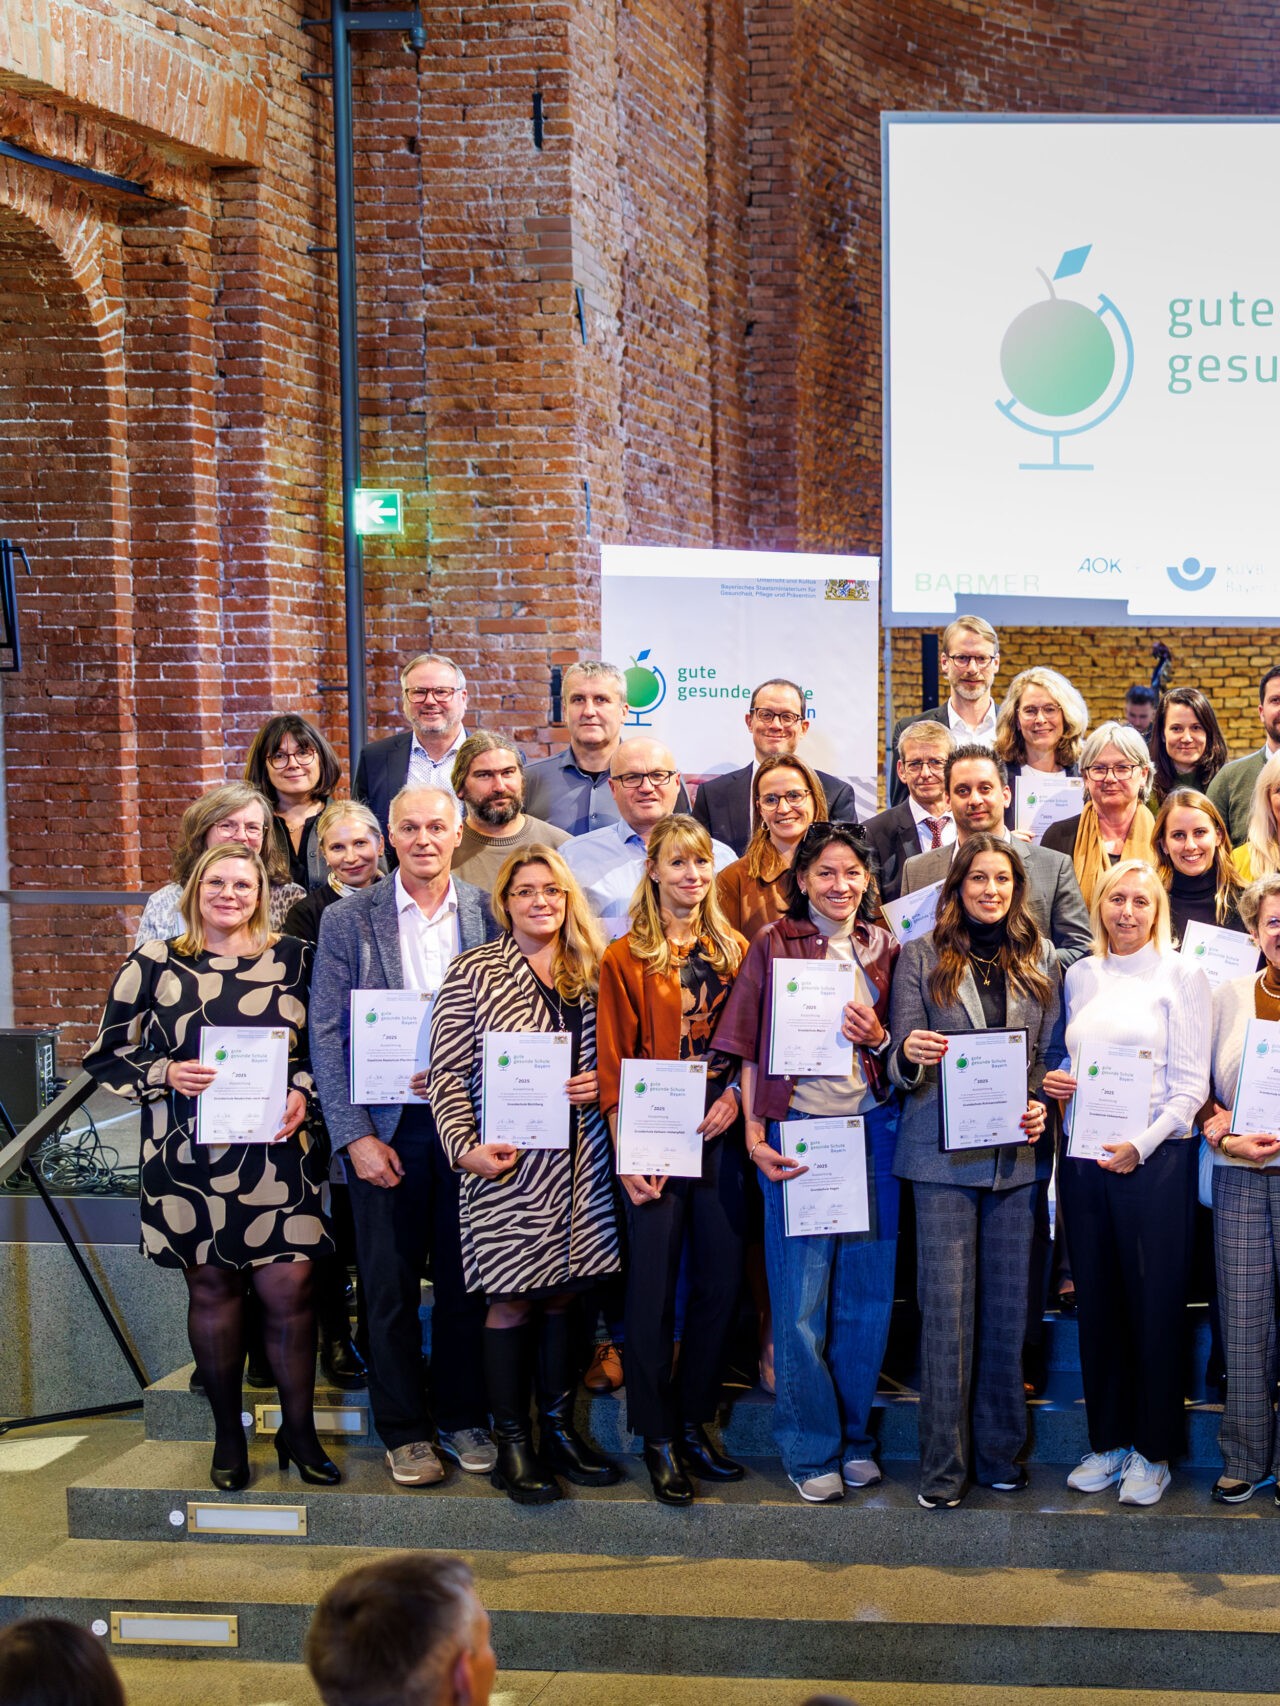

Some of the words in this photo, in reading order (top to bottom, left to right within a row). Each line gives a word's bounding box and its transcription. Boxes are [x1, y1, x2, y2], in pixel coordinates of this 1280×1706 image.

[1167, 291, 1274, 338] gute
[1078, 557, 1122, 574] AOK
[915, 573, 1040, 594] BARMER
[678, 666, 717, 682] gute
[678, 685, 751, 701] gesunde
